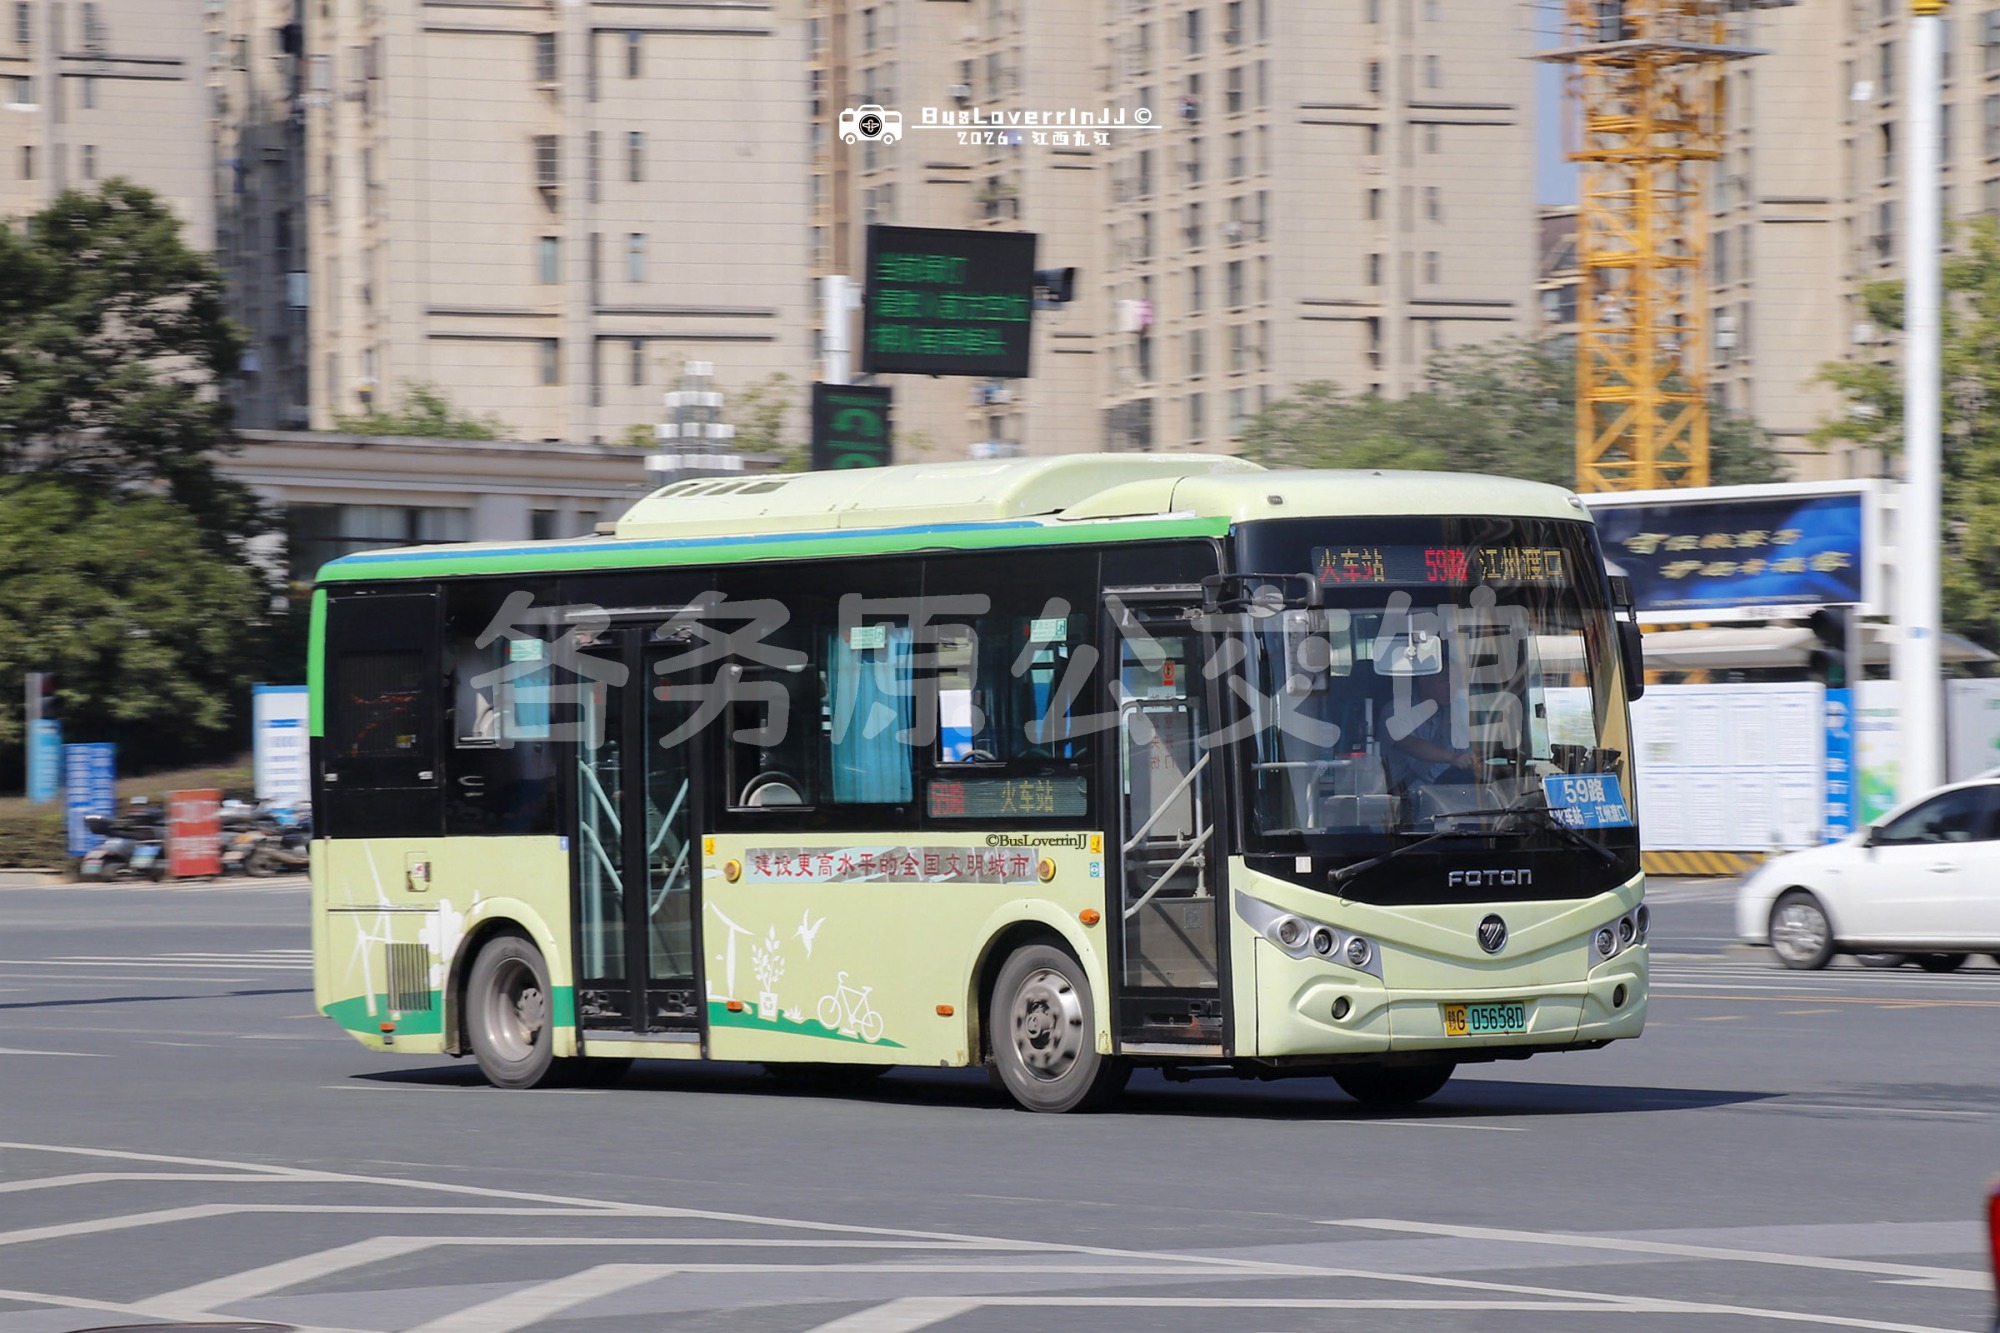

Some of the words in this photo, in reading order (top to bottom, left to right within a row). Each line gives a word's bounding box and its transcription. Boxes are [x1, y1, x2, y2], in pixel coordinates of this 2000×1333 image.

[1319, 548, 1386, 582] 火车站
[1478, 547, 1563, 581] 江州渡口
[1000, 780, 1055, 813] 火车站
[1563, 778, 1606, 803] 59路
[753, 852, 1030, 878] 建设更高水平的全国文明城市
[1448, 868, 1533, 887] FOTON
